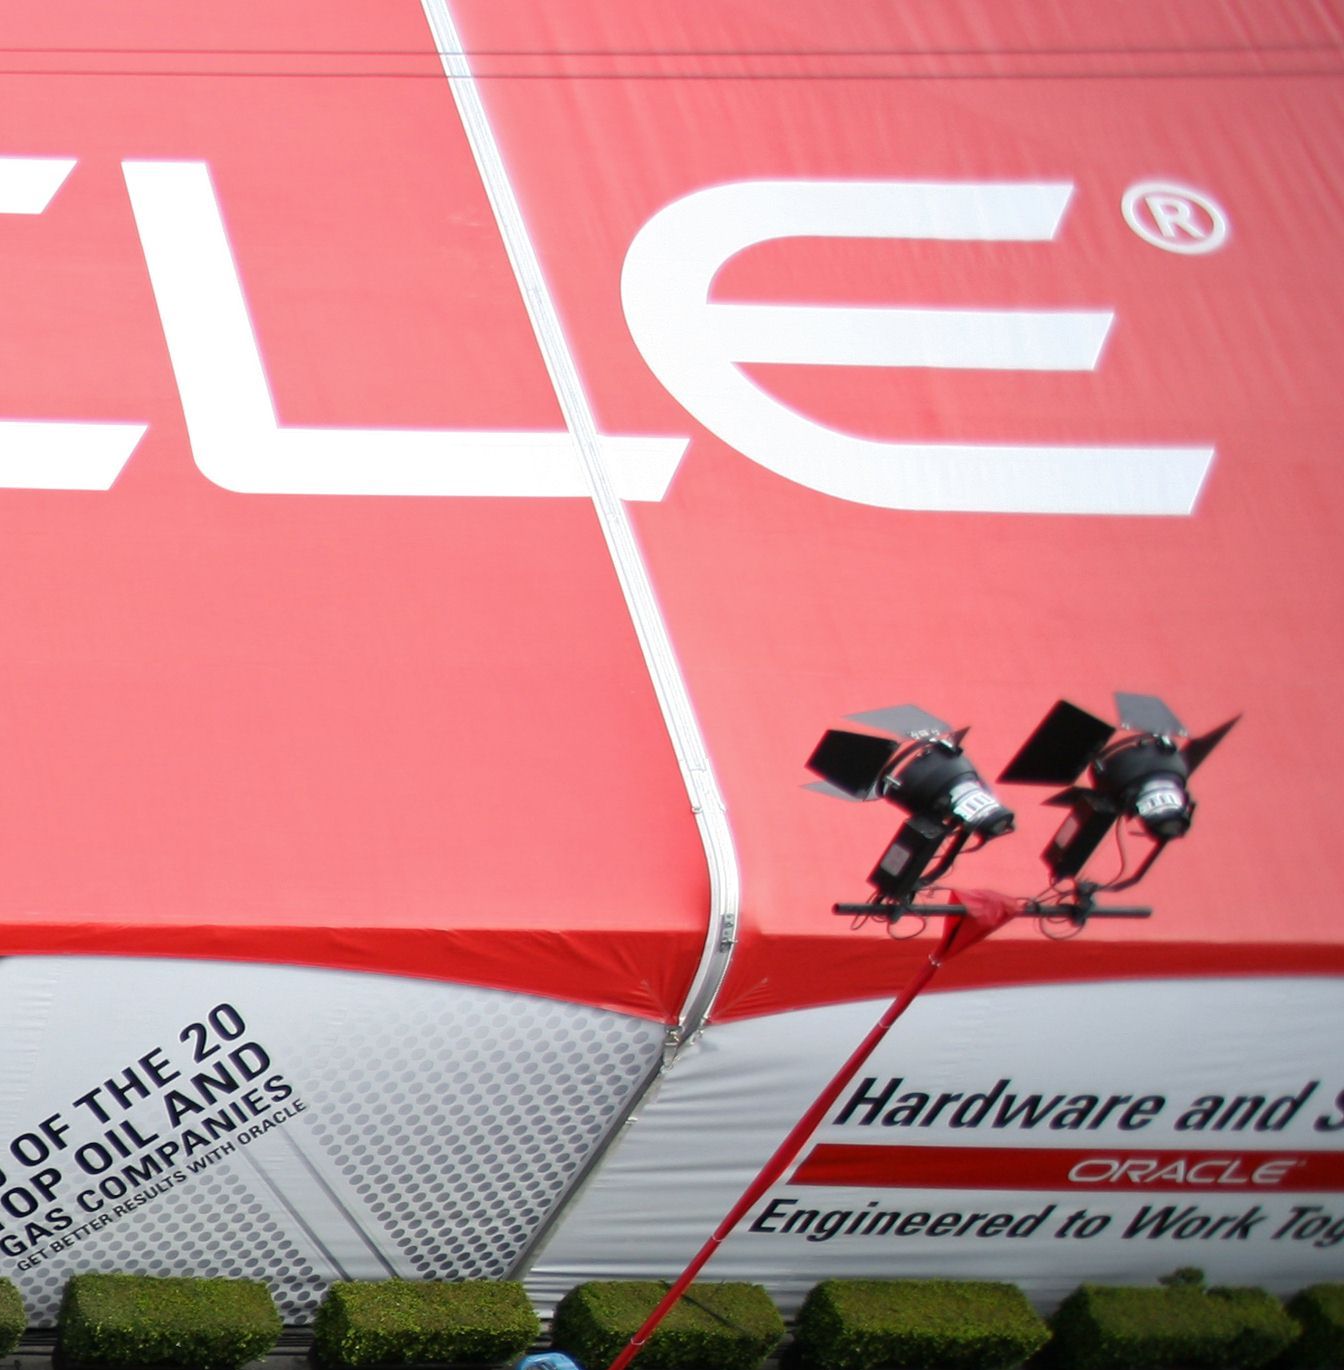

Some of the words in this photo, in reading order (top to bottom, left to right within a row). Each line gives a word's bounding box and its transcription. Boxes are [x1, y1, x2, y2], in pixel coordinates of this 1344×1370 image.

[10, 1112, 70, 1167] OF
[73, 1047, 181, 1125] THE
[179, 1002, 246, 1064] 20
[74, 1119, 160, 1175] OIL
[163, 1041, 271, 1128] AND
[76, 1074, 293, 1214] COMPANIES
[831, 1076, 1166, 1131] Hardware
[1174, 1079, 1320, 1132] and
[17, 1248, 49, 1271] GET
[49, 1213, 113, 1253] BETTER
[112, 1170, 187, 1217] RESULTS
[186, 1140, 236, 1174] WITH
[237, 1097, 307, 1146] ORACLE
[748, 1198, 1058, 1243] Engineered
[1054, 1208, 1112, 1240] to
[1121, 1205, 1268, 1240] Work
[1067, 1158, 1299, 1184] ORACLE
